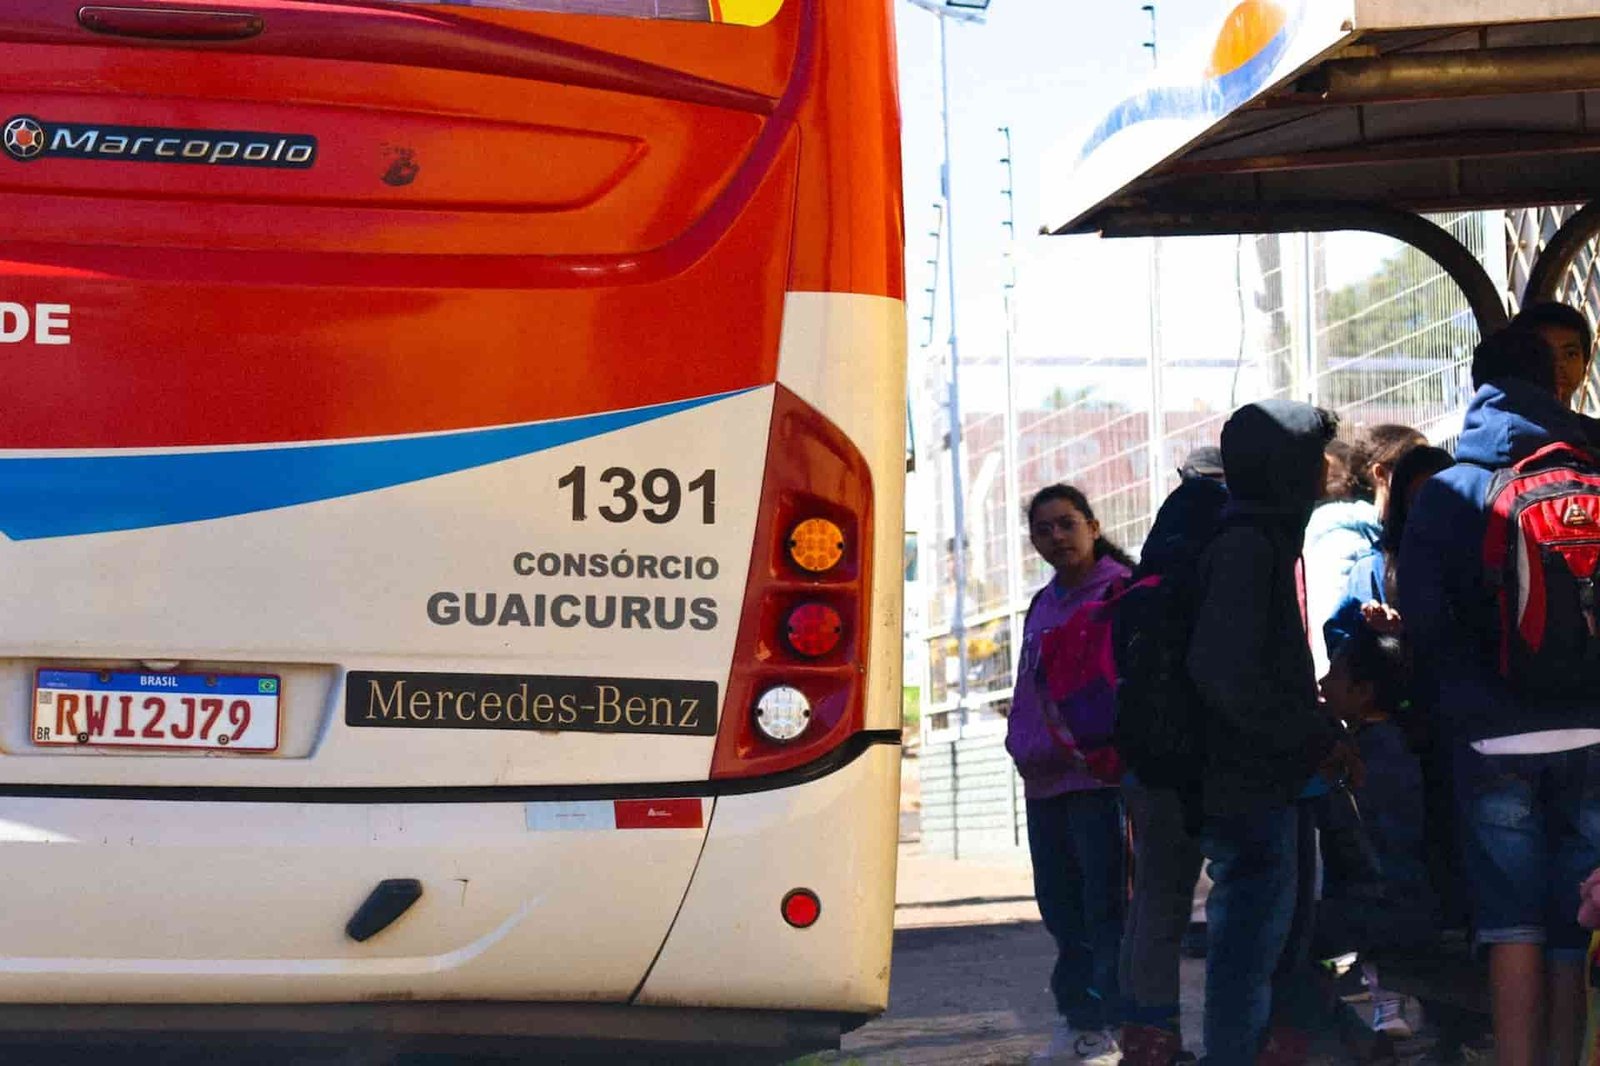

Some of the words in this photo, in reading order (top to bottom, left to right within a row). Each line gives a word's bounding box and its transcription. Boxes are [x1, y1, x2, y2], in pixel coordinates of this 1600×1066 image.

[49, 128, 313, 164] Marcopolo
[558, 465, 718, 525] 1391
[513, 549, 719, 580] CONSÓRCIO
[426, 591, 719, 631] GUAICURUS
[140, 675, 178, 687] BRASIL
[55, 693, 251, 741] RWI2J79
[365, 679, 700, 728] Mercedes-Benz
[36, 726, 51, 741] BR
